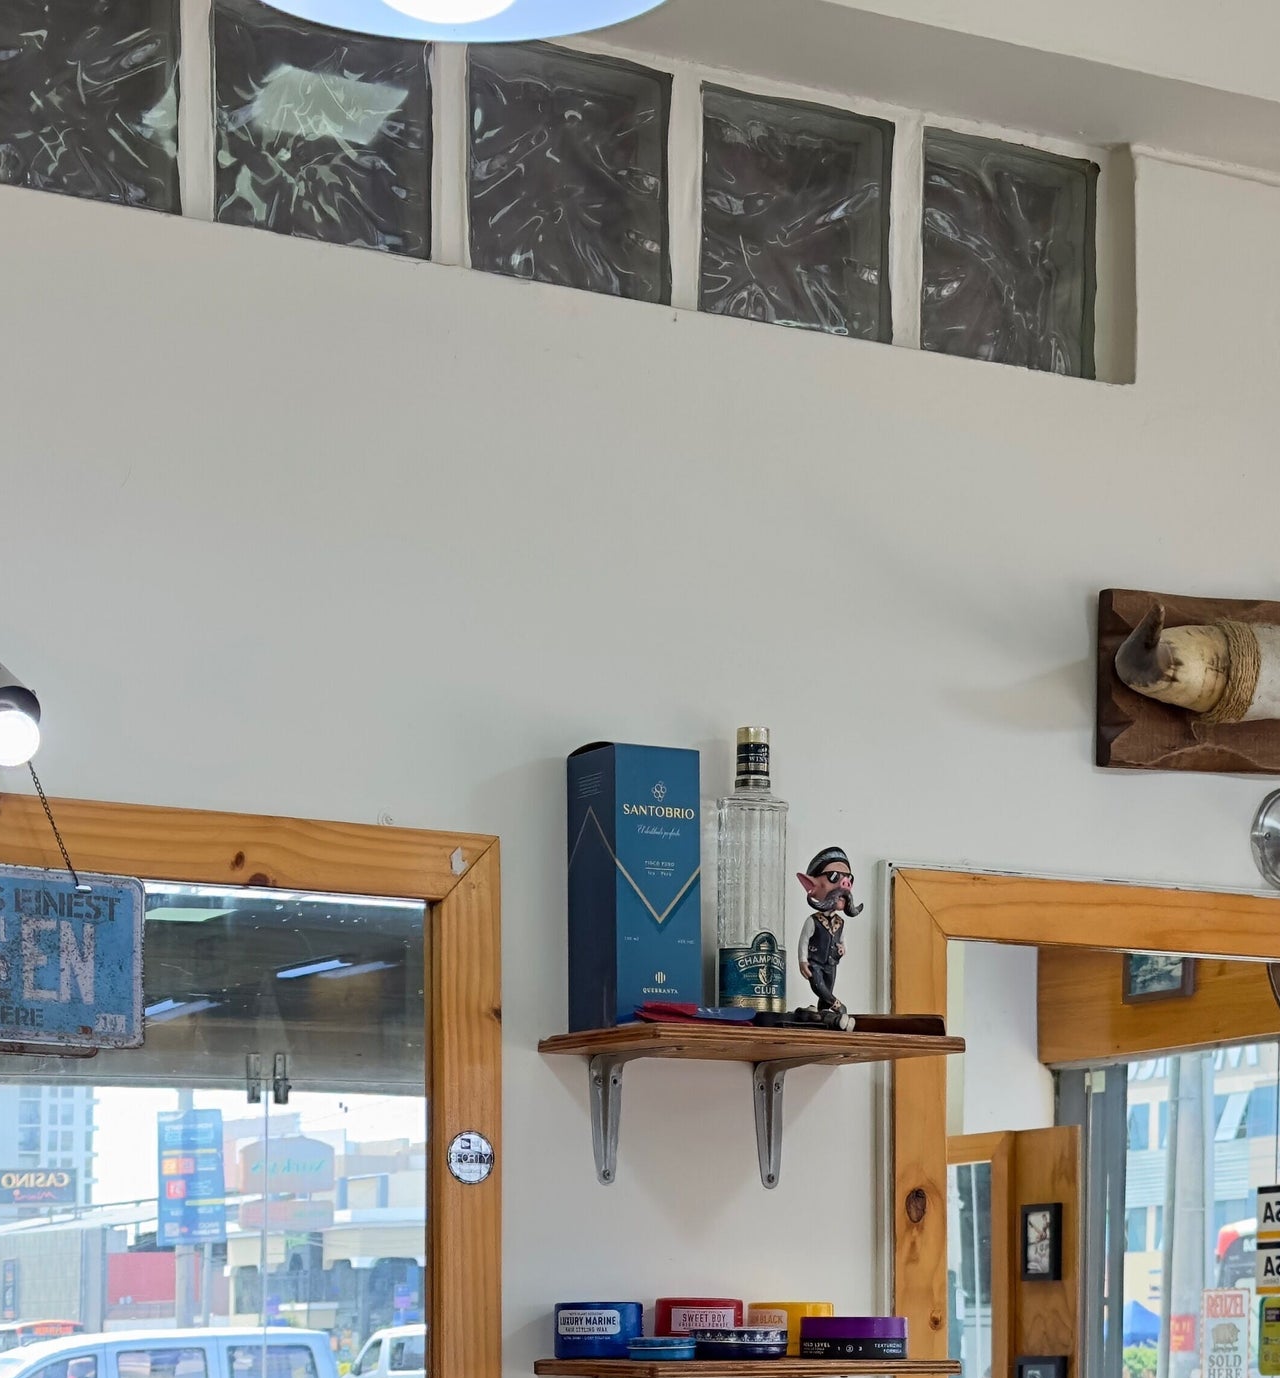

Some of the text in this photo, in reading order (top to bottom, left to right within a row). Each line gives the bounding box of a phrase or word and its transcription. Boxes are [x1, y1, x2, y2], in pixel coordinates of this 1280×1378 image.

[623, 803, 695, 820] SANTOBRIO
[642, 987, 679, 995] QUEBRANTA
[754, 985, 777, 996] CLUB
[560, 1315, 617, 1327] LUXURY MARINE
[682, 1311, 726, 1323] SWEET BOY
[760, 1314, 784, 1325] BLACK
[1207, 1354, 1242, 1368] SOLD
